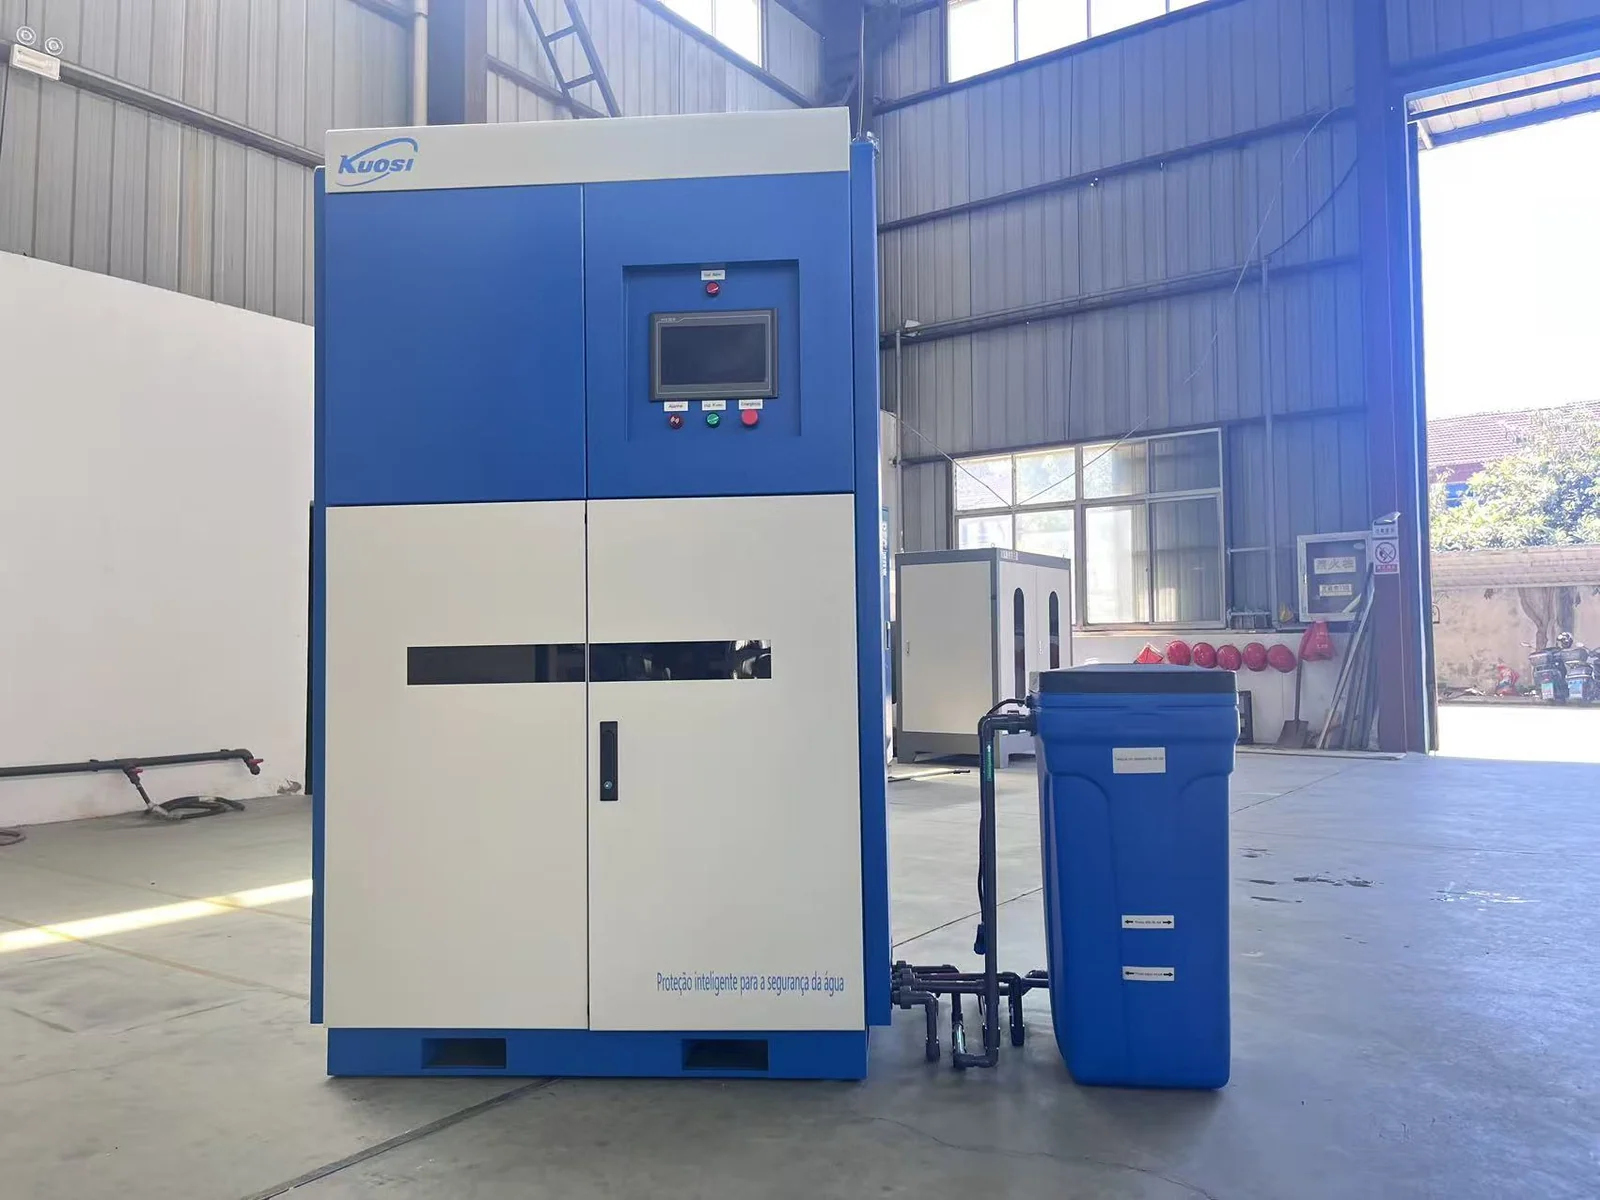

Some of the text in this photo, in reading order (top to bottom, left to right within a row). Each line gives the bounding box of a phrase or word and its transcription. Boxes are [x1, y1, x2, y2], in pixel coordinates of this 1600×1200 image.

[657, 971, 692, 996] Proteção
[694, 970, 738, 996] inteligente
[740, 975, 758, 996] para
[760, 976, 766, 991] a
[767, 975, 810, 996] segurança
[823, 970, 845, 997] água
